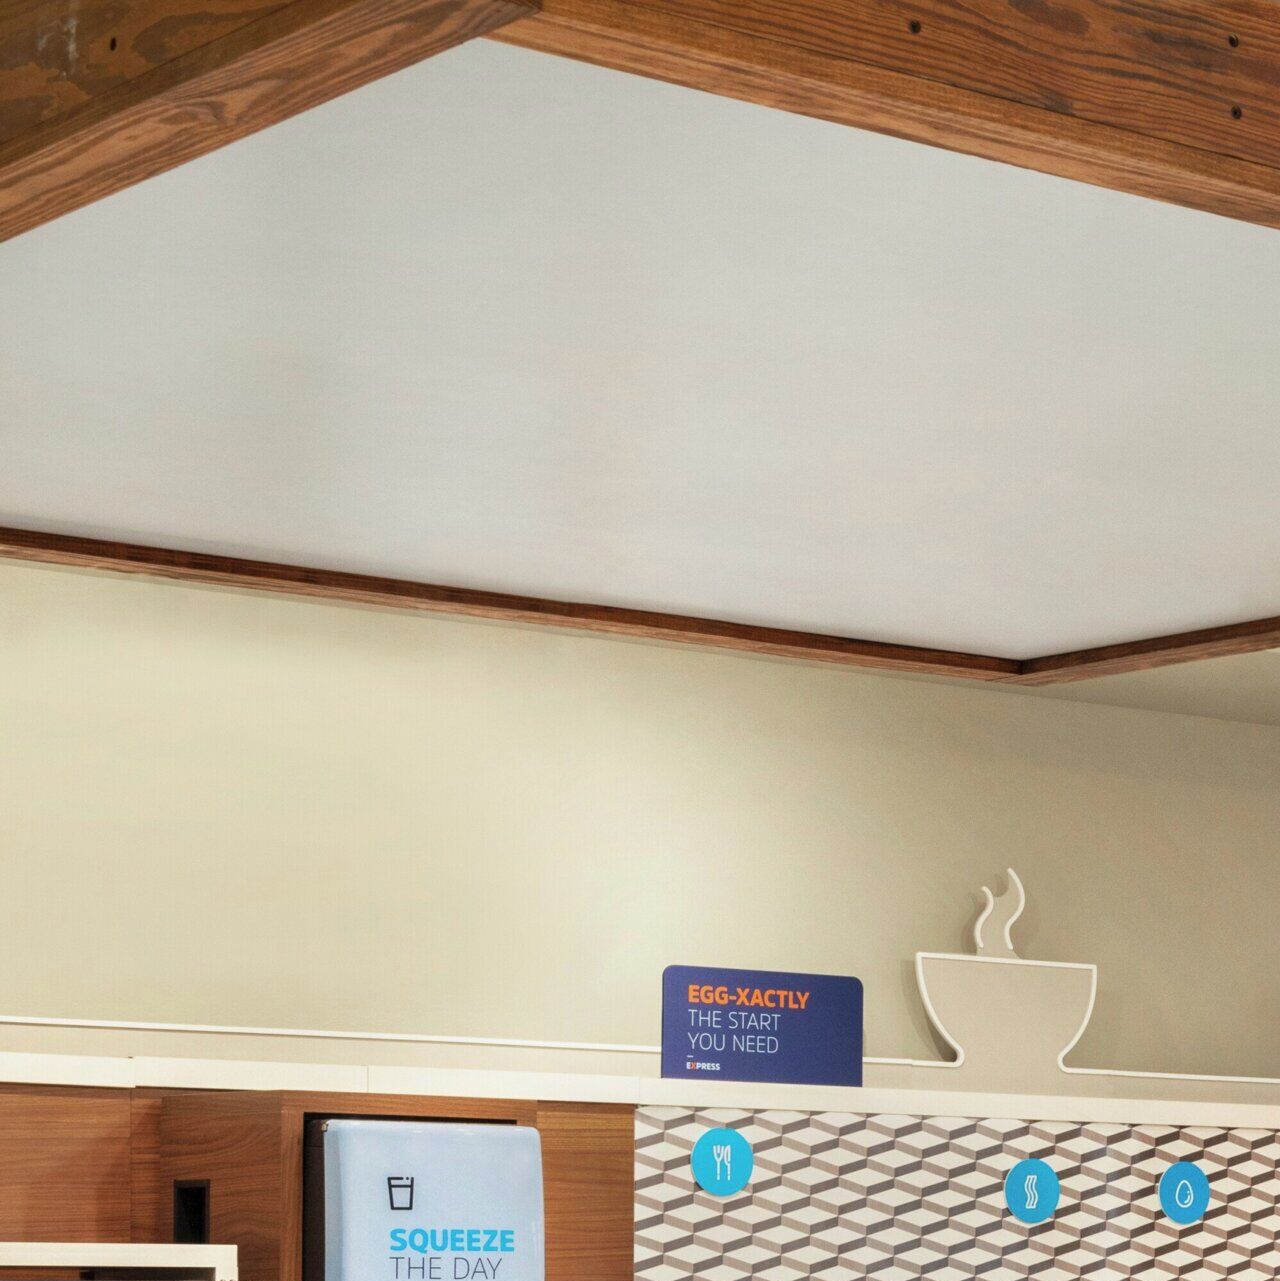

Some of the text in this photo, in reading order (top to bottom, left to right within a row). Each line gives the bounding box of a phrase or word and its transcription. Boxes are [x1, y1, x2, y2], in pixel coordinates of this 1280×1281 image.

[688, 984, 810, 1009] EGG-XACTLY
[688, 1009, 781, 1031] THE START
[688, 1032, 779, 1054] YOU NEED
[686, 1062, 721, 1071] EXPRESS
[390, 1228, 515, 1254] SQUEEZE
[389, 1257, 502, 1280] THE DAY
